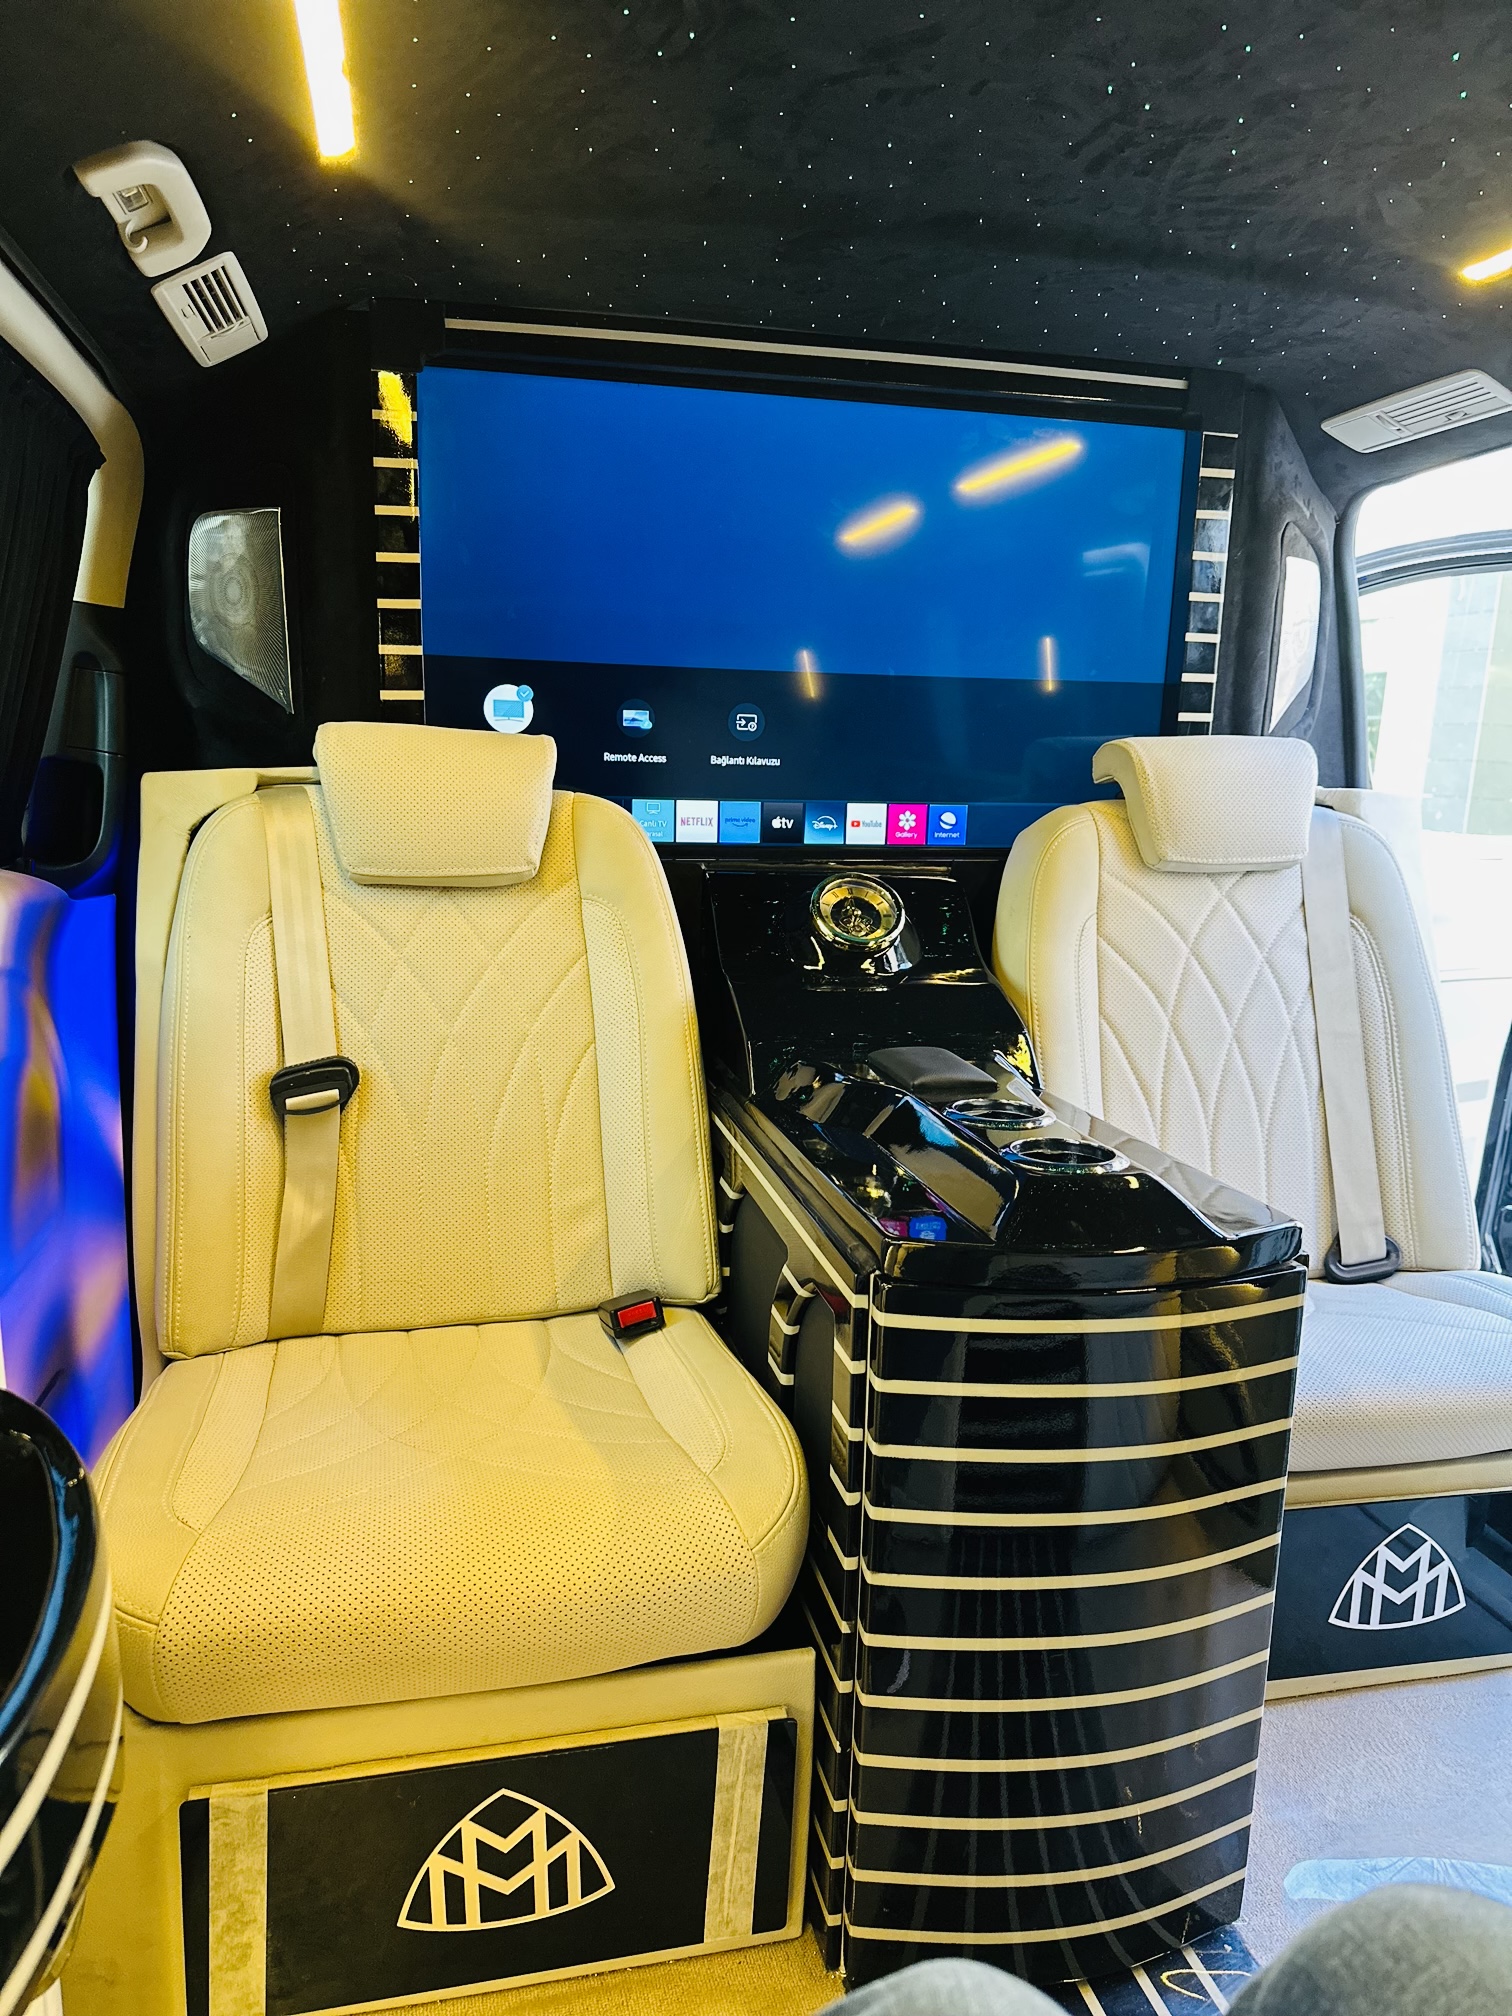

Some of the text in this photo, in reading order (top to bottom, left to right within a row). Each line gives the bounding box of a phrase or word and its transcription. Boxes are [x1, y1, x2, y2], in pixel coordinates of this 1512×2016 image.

[603, 752, 667, 763] Remote Access
[710, 755, 781, 767] Bağlantı Kılavuzu
[657, 820, 667, 828] TV
[680, 817, 713, 827] NETFLIX
[781, 817, 794, 829] tv
[862, 819, 882, 828] YouTube
[895, 831, 918, 839] Gallery
